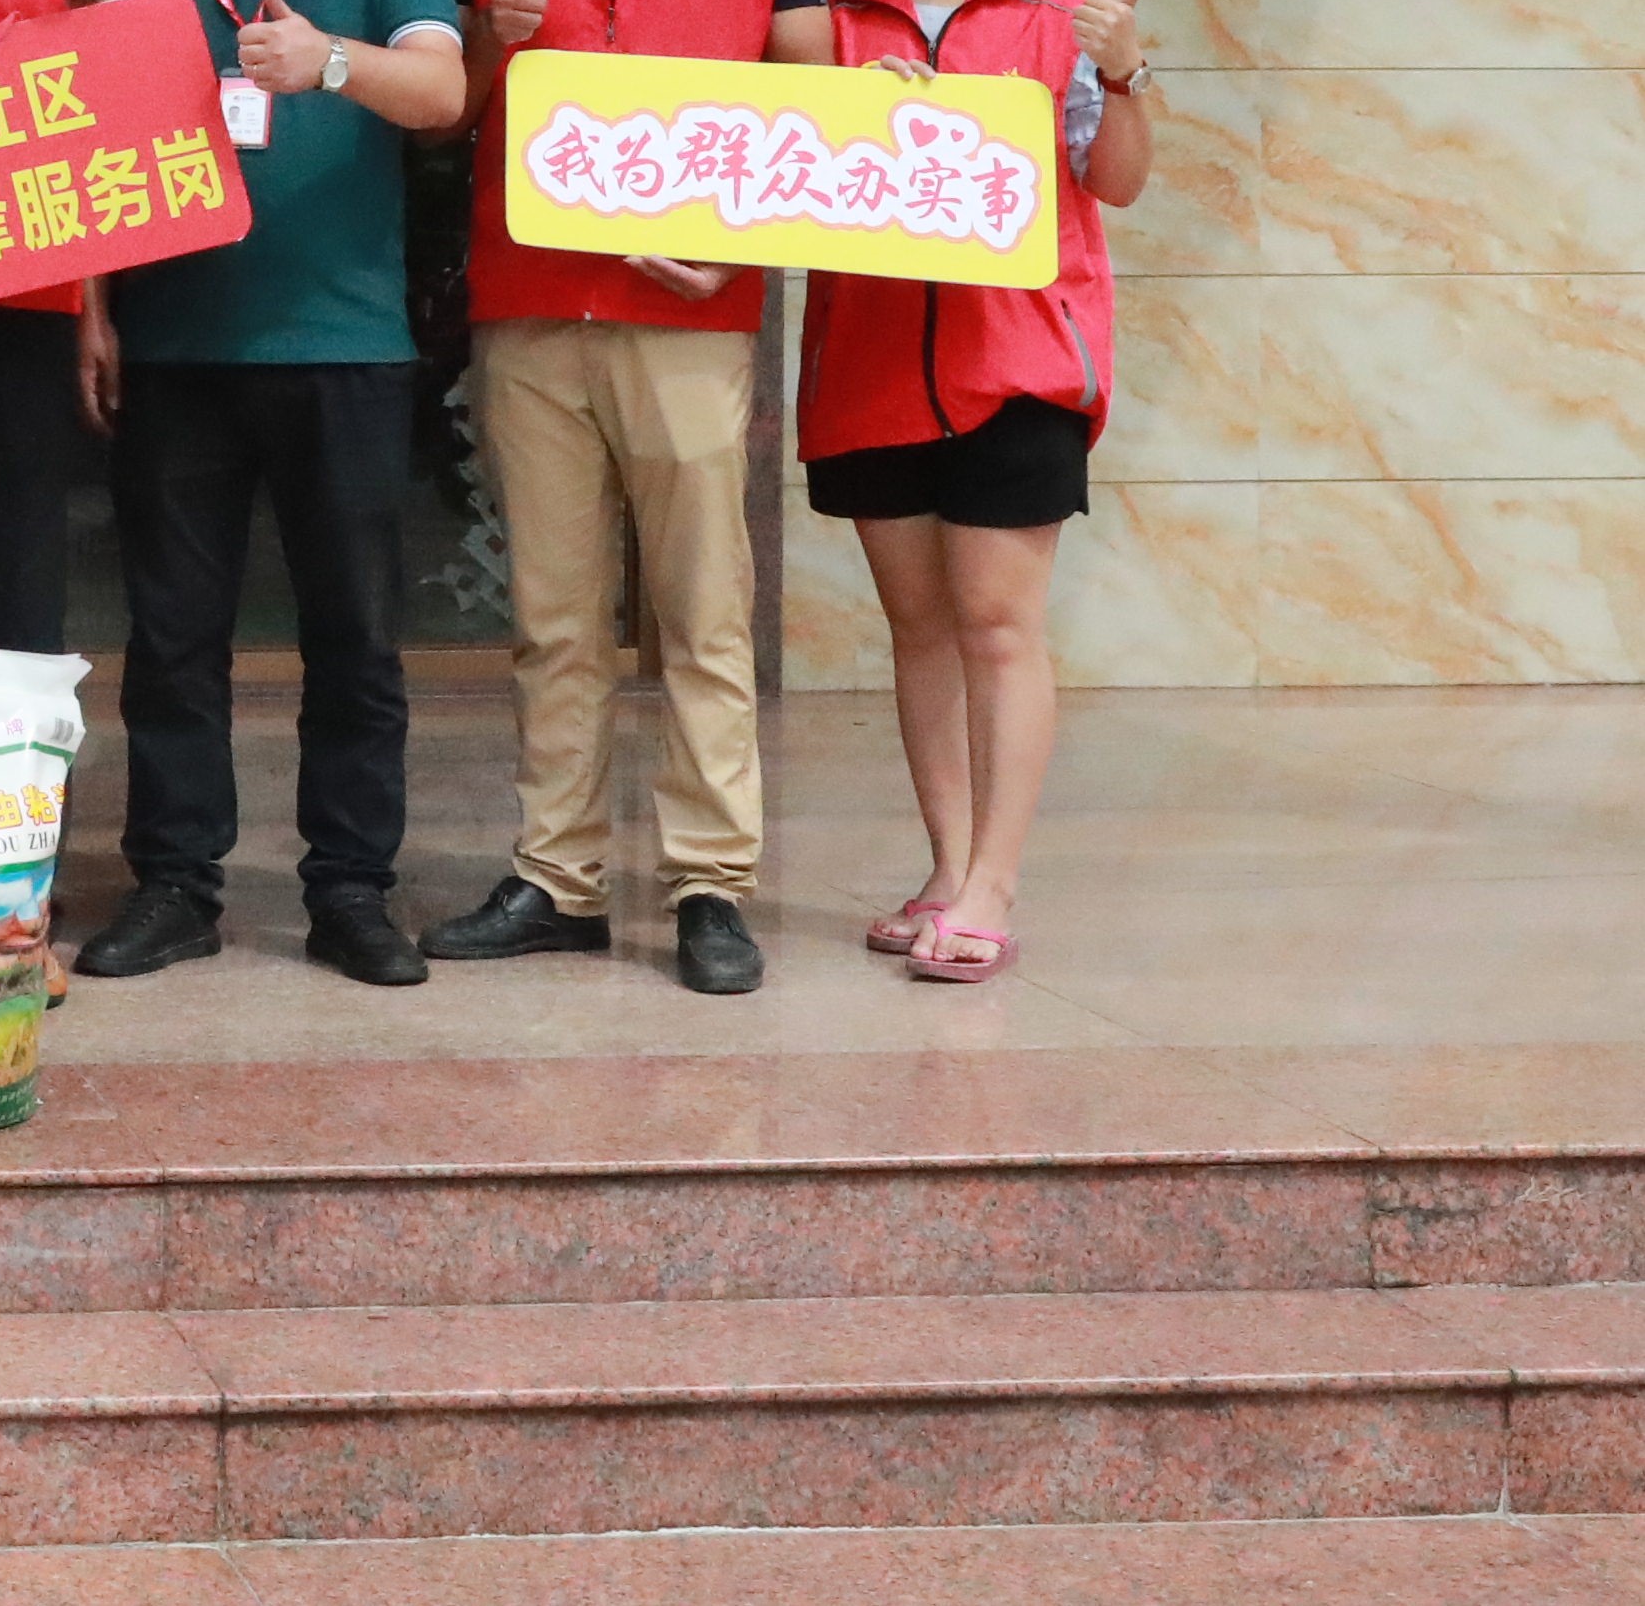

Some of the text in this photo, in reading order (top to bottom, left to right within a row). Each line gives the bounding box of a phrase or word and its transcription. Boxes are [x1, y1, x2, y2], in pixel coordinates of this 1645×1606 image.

[543, 120, 1021, 234] 我为群众办实事
